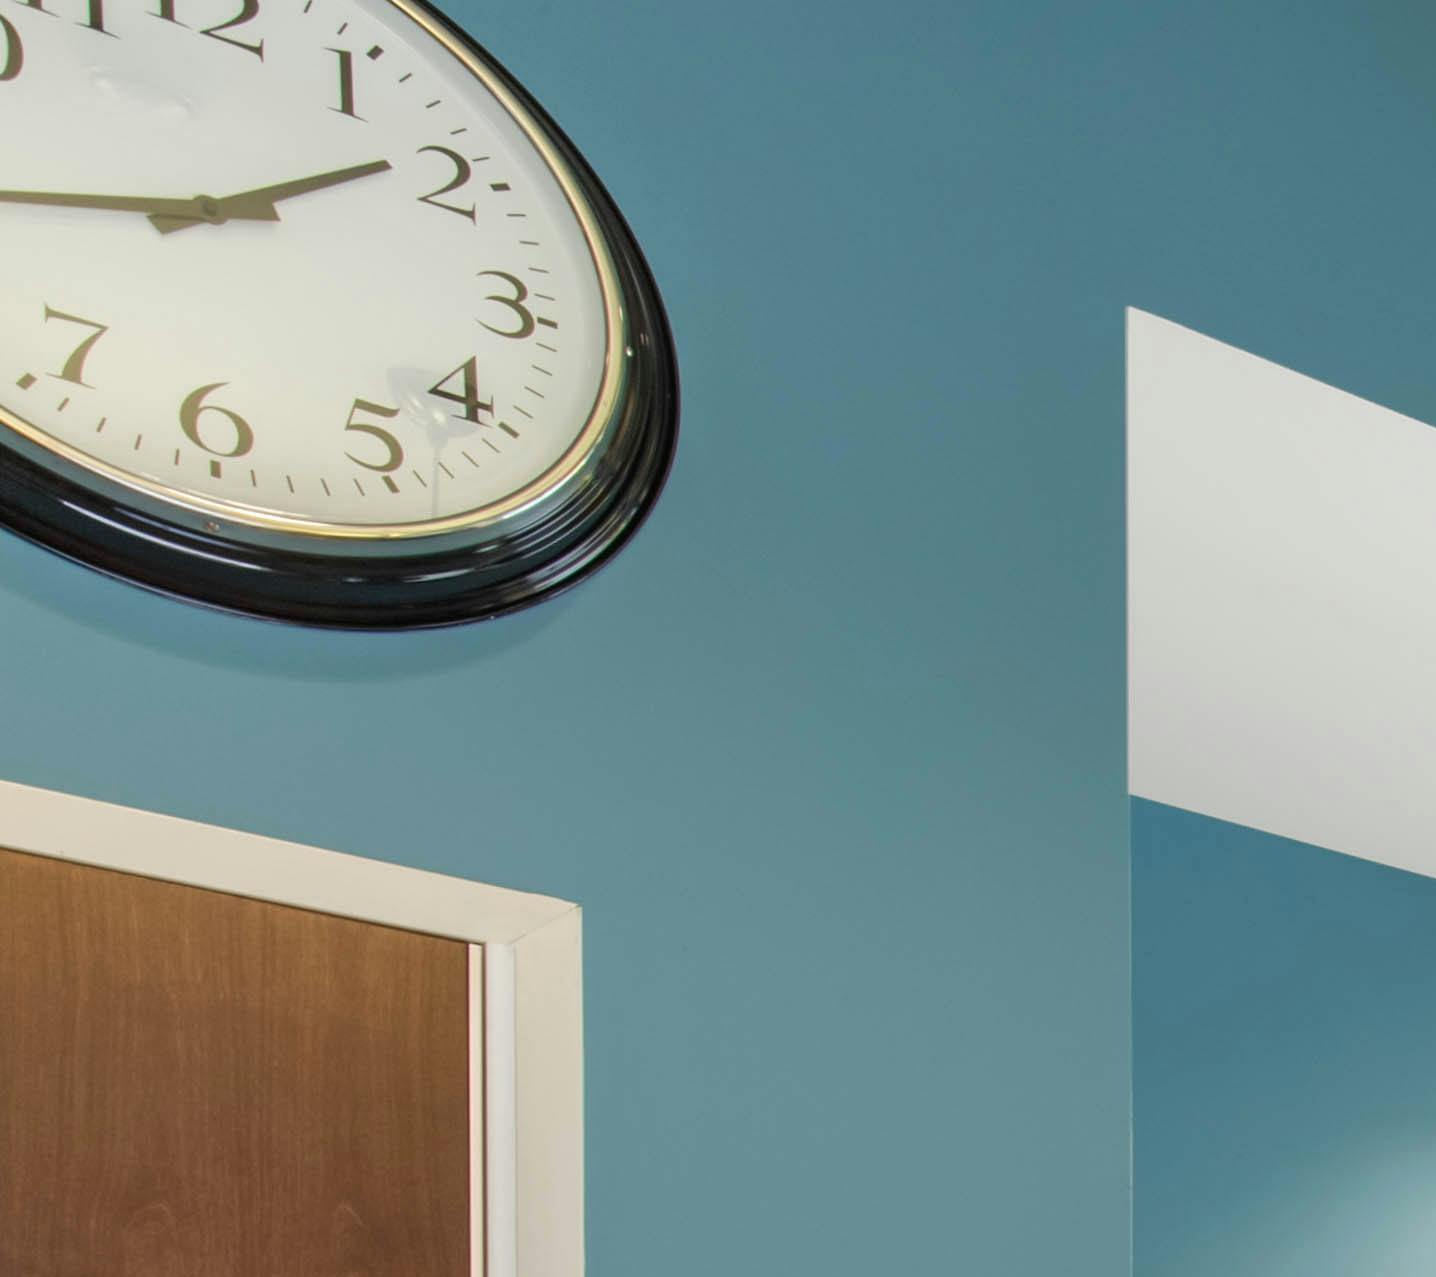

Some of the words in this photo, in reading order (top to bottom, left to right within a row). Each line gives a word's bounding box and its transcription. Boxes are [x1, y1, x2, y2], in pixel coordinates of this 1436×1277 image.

[323, 46, 370, 123] 1
[416, 145, 477, 226] 2
[475, 270, 536, 339] 3
[44, 302, 110, 390] 7
[179, 382, 255, 459] 6
[428, 355, 495, 428] 4
[343, 398, 404, 473] 5
